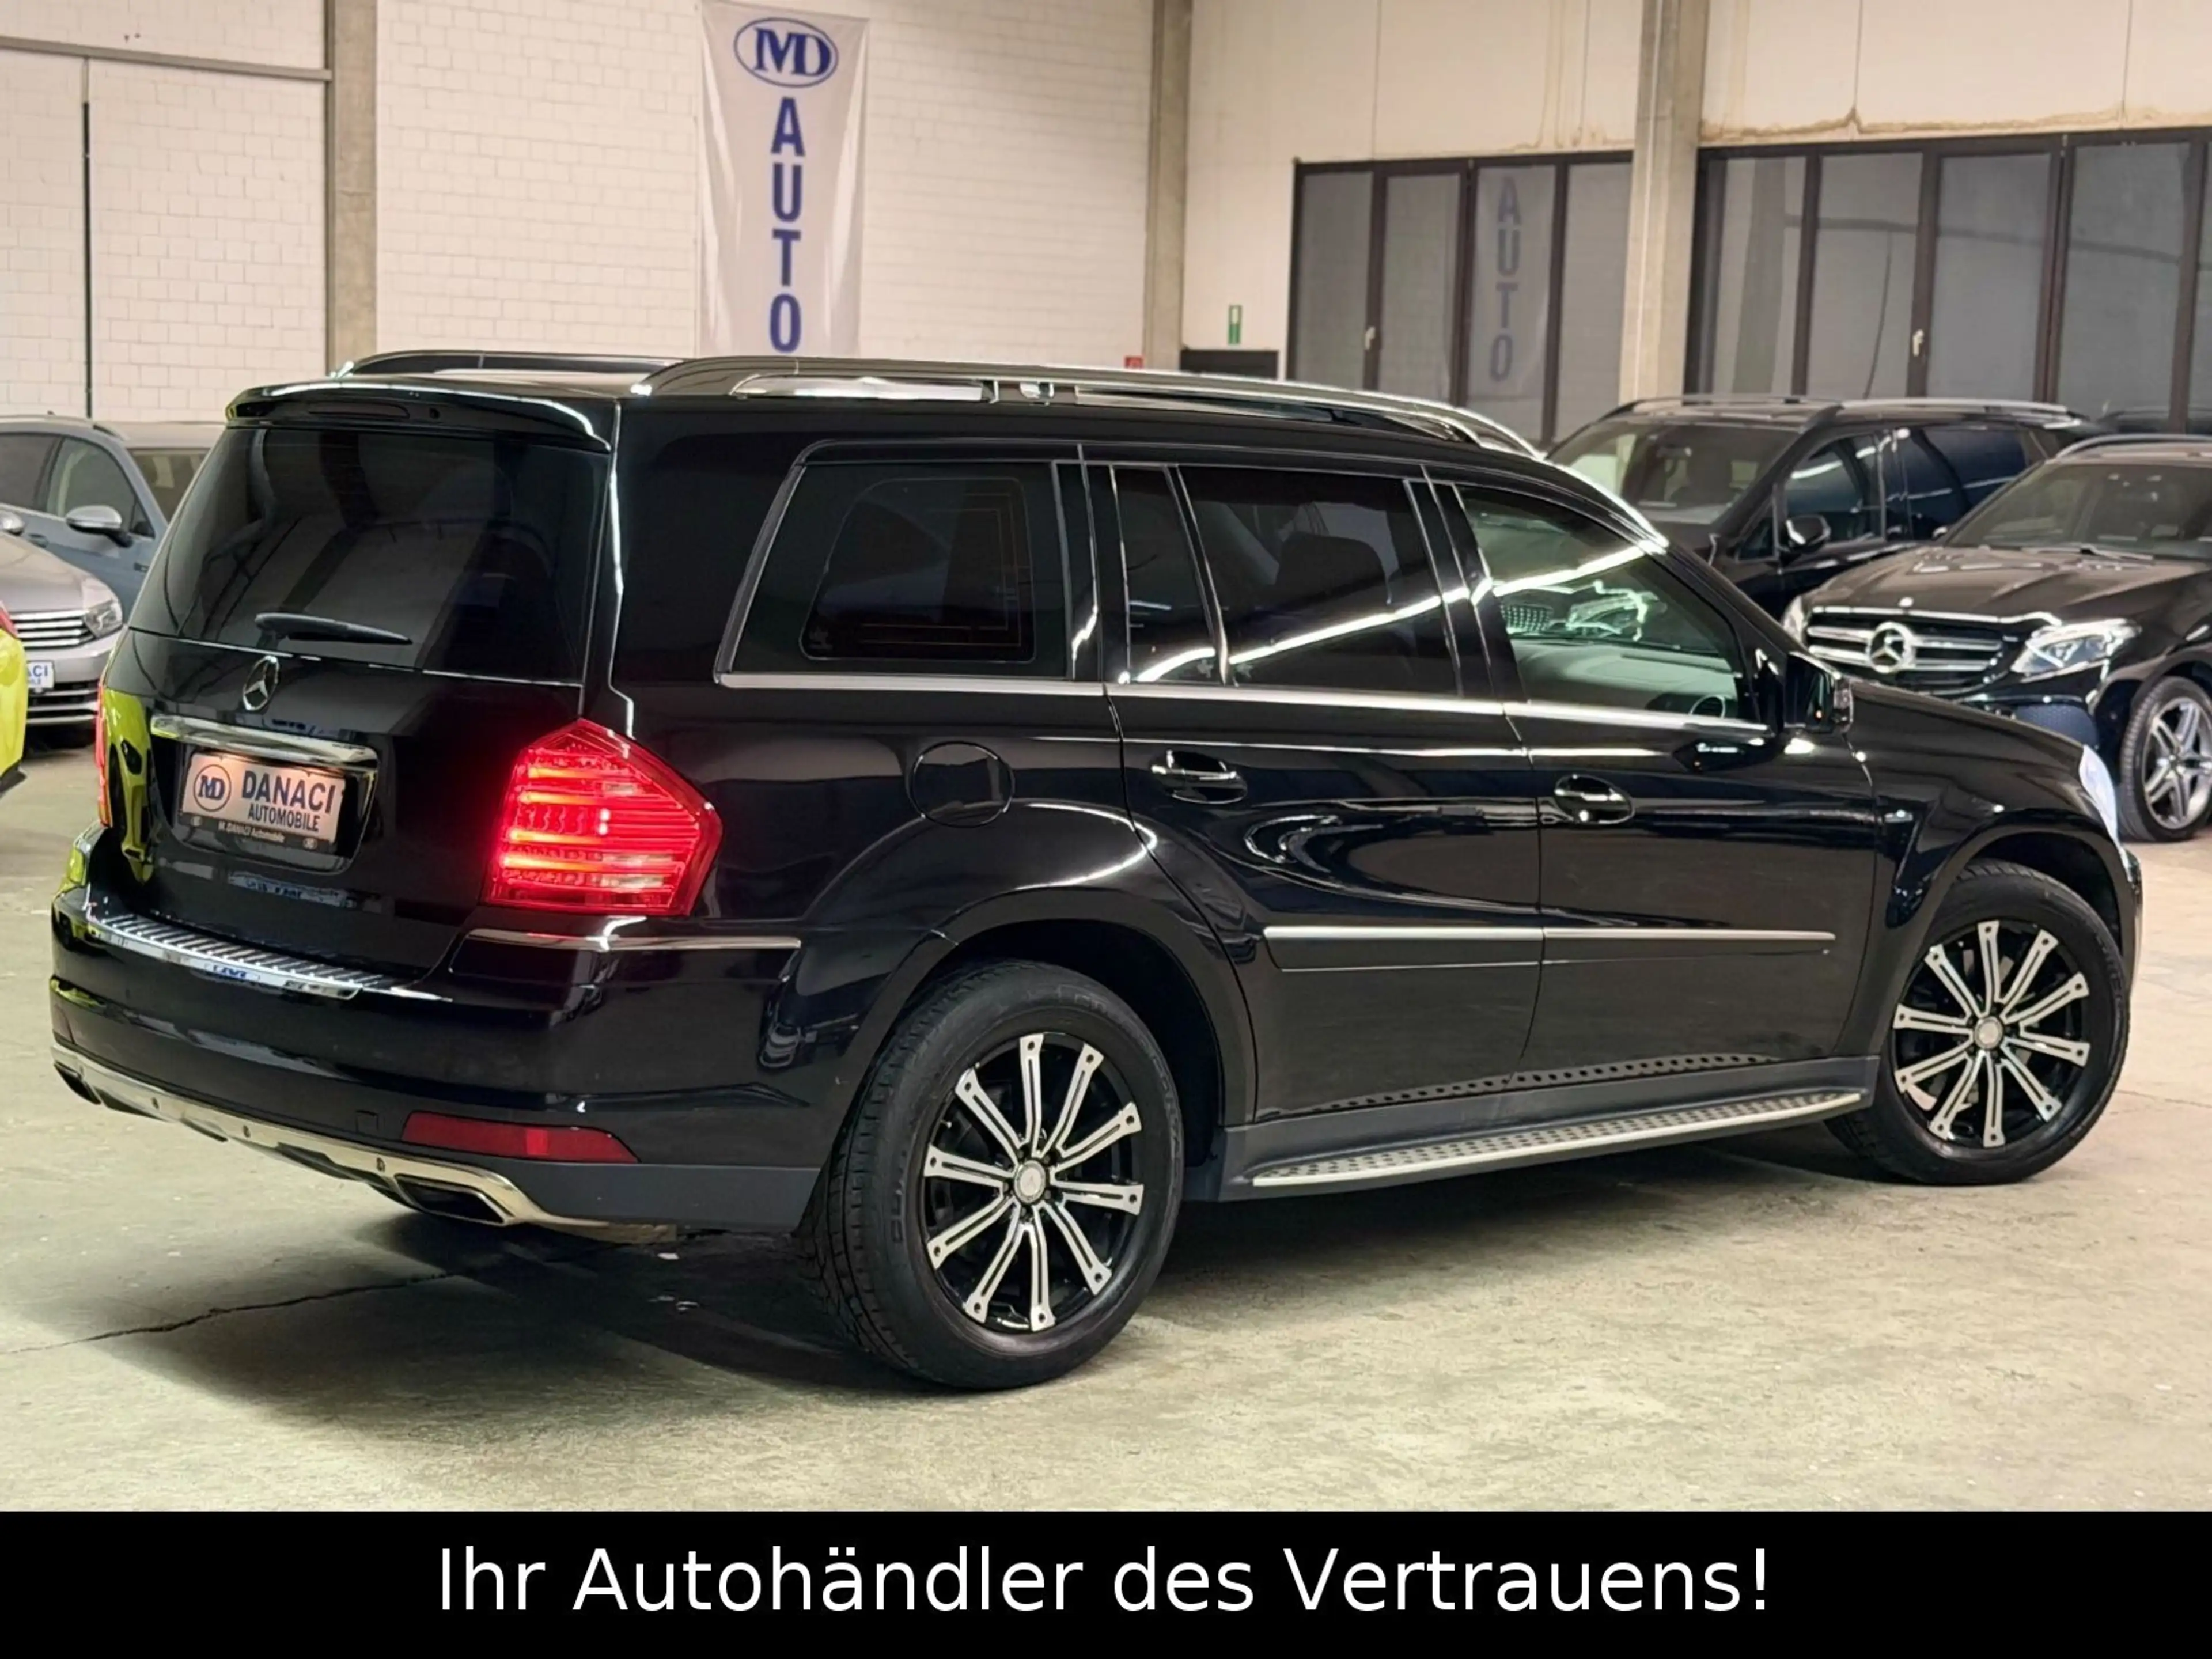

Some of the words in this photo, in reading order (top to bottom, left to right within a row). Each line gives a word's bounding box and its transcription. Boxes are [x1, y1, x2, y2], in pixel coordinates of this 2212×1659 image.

[753, 27, 832, 77] MD
[769, 97, 805, 354] AUTO
[198, 775, 226, 800] MD
[241, 770, 336, 814] DANACI
[248, 803, 321, 832] AUTOMOBILE
